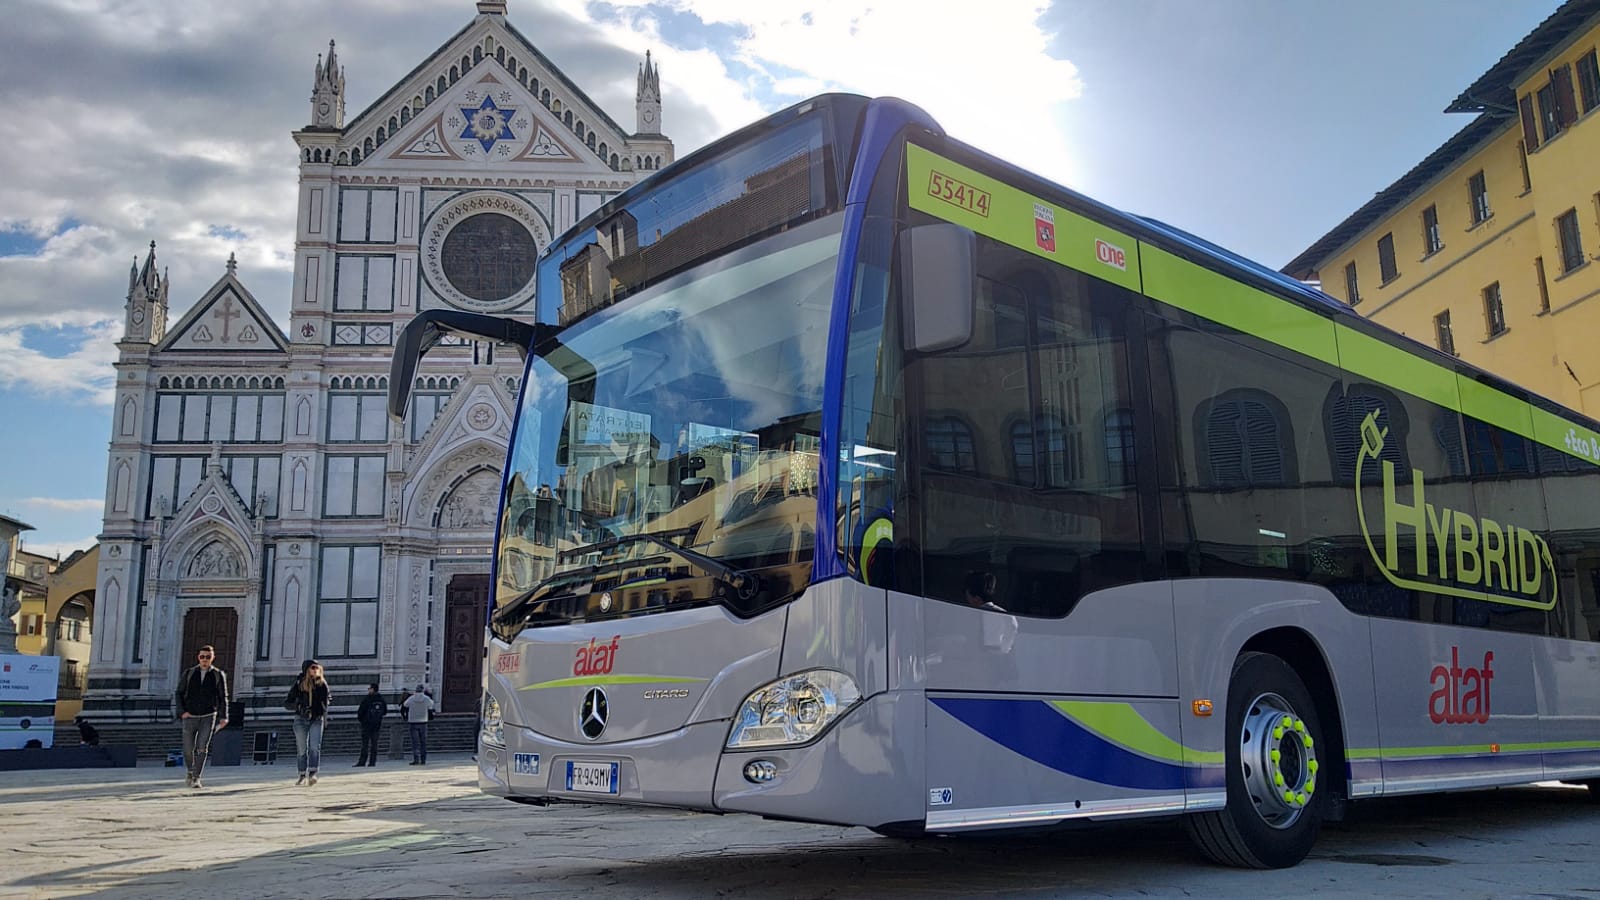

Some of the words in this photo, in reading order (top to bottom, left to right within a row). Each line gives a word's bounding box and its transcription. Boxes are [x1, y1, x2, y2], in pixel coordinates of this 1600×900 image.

[931, 174, 987, 213] 55414
[1383, 460, 1542, 595] HYBRID
[497, 655, 520, 671] 55414
[573, 635, 621, 676] ataf
[643, 689, 689, 699] CITARO
[1428, 646, 1494, 724] ataf
